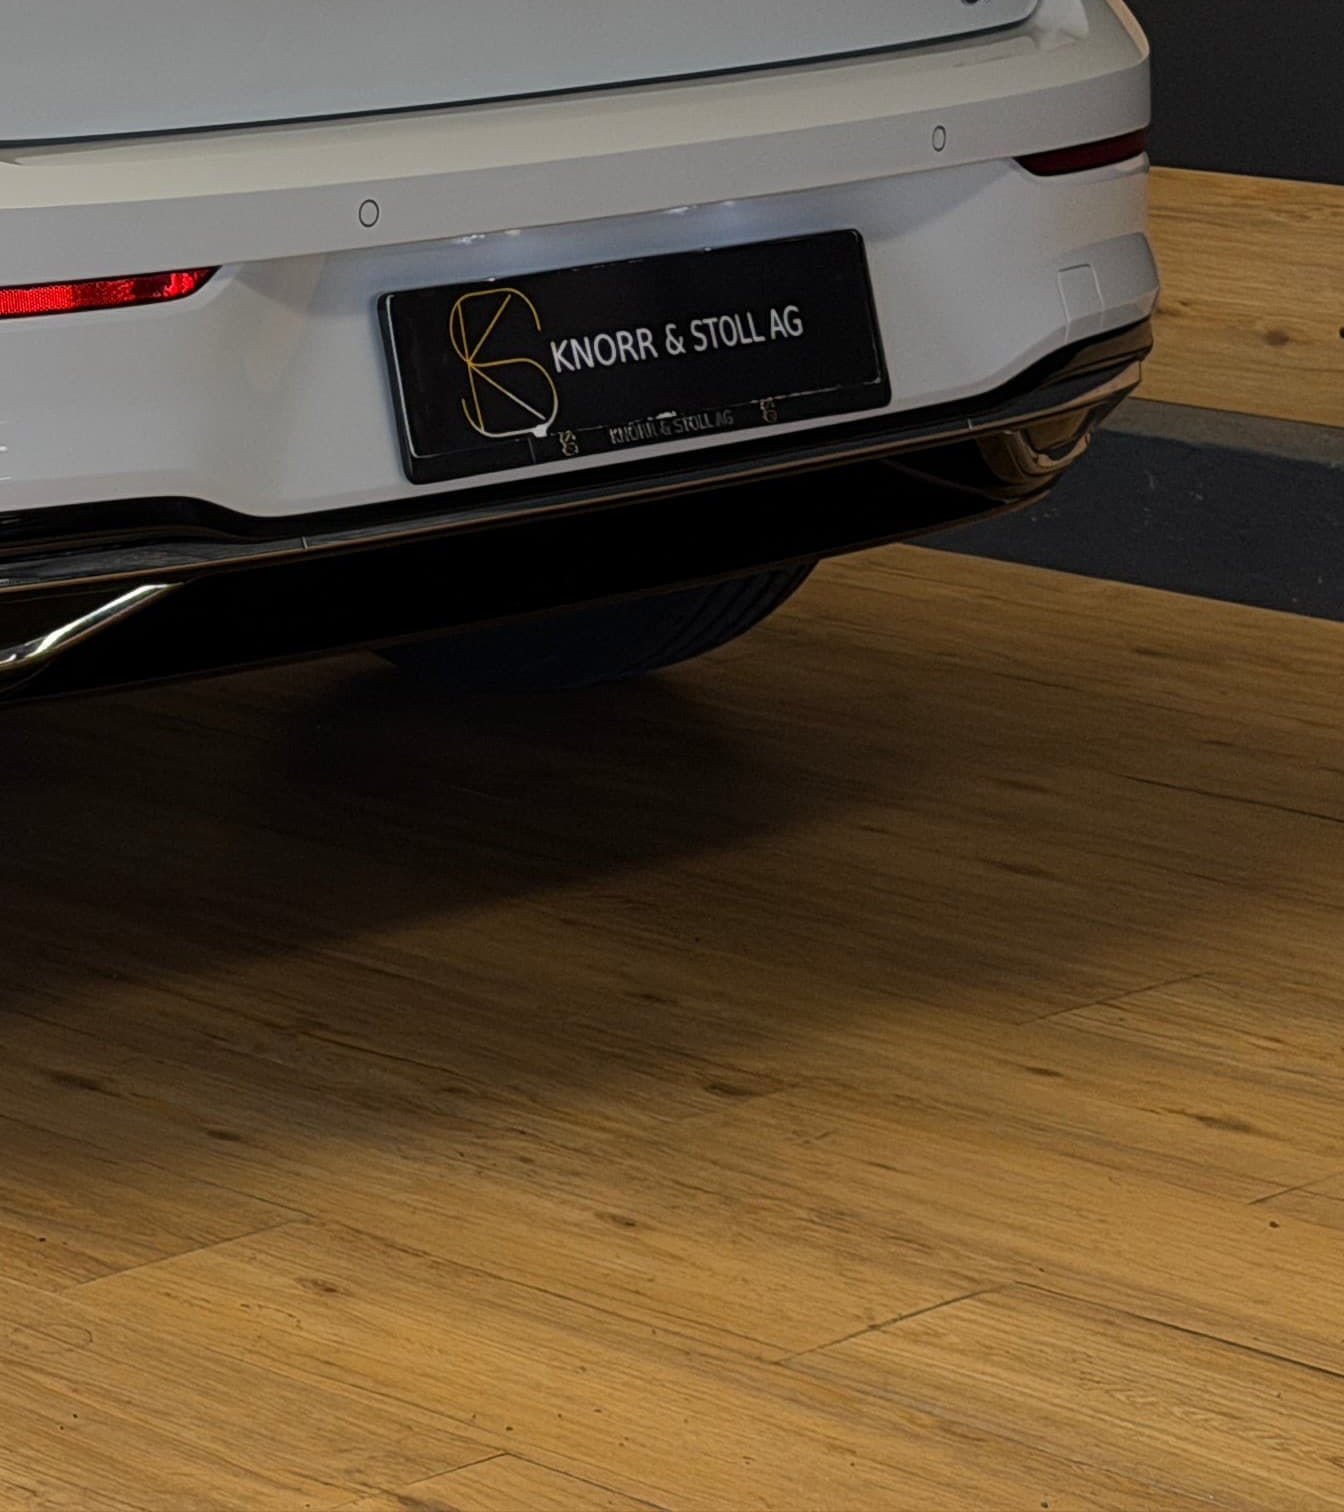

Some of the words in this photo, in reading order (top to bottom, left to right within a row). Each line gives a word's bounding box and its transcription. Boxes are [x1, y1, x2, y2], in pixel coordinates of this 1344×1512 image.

[550, 327, 659, 373] KNORR
[665, 323, 686, 356] &
[690, 312, 766, 352] STOLL
[770, 305, 804, 339] AG
